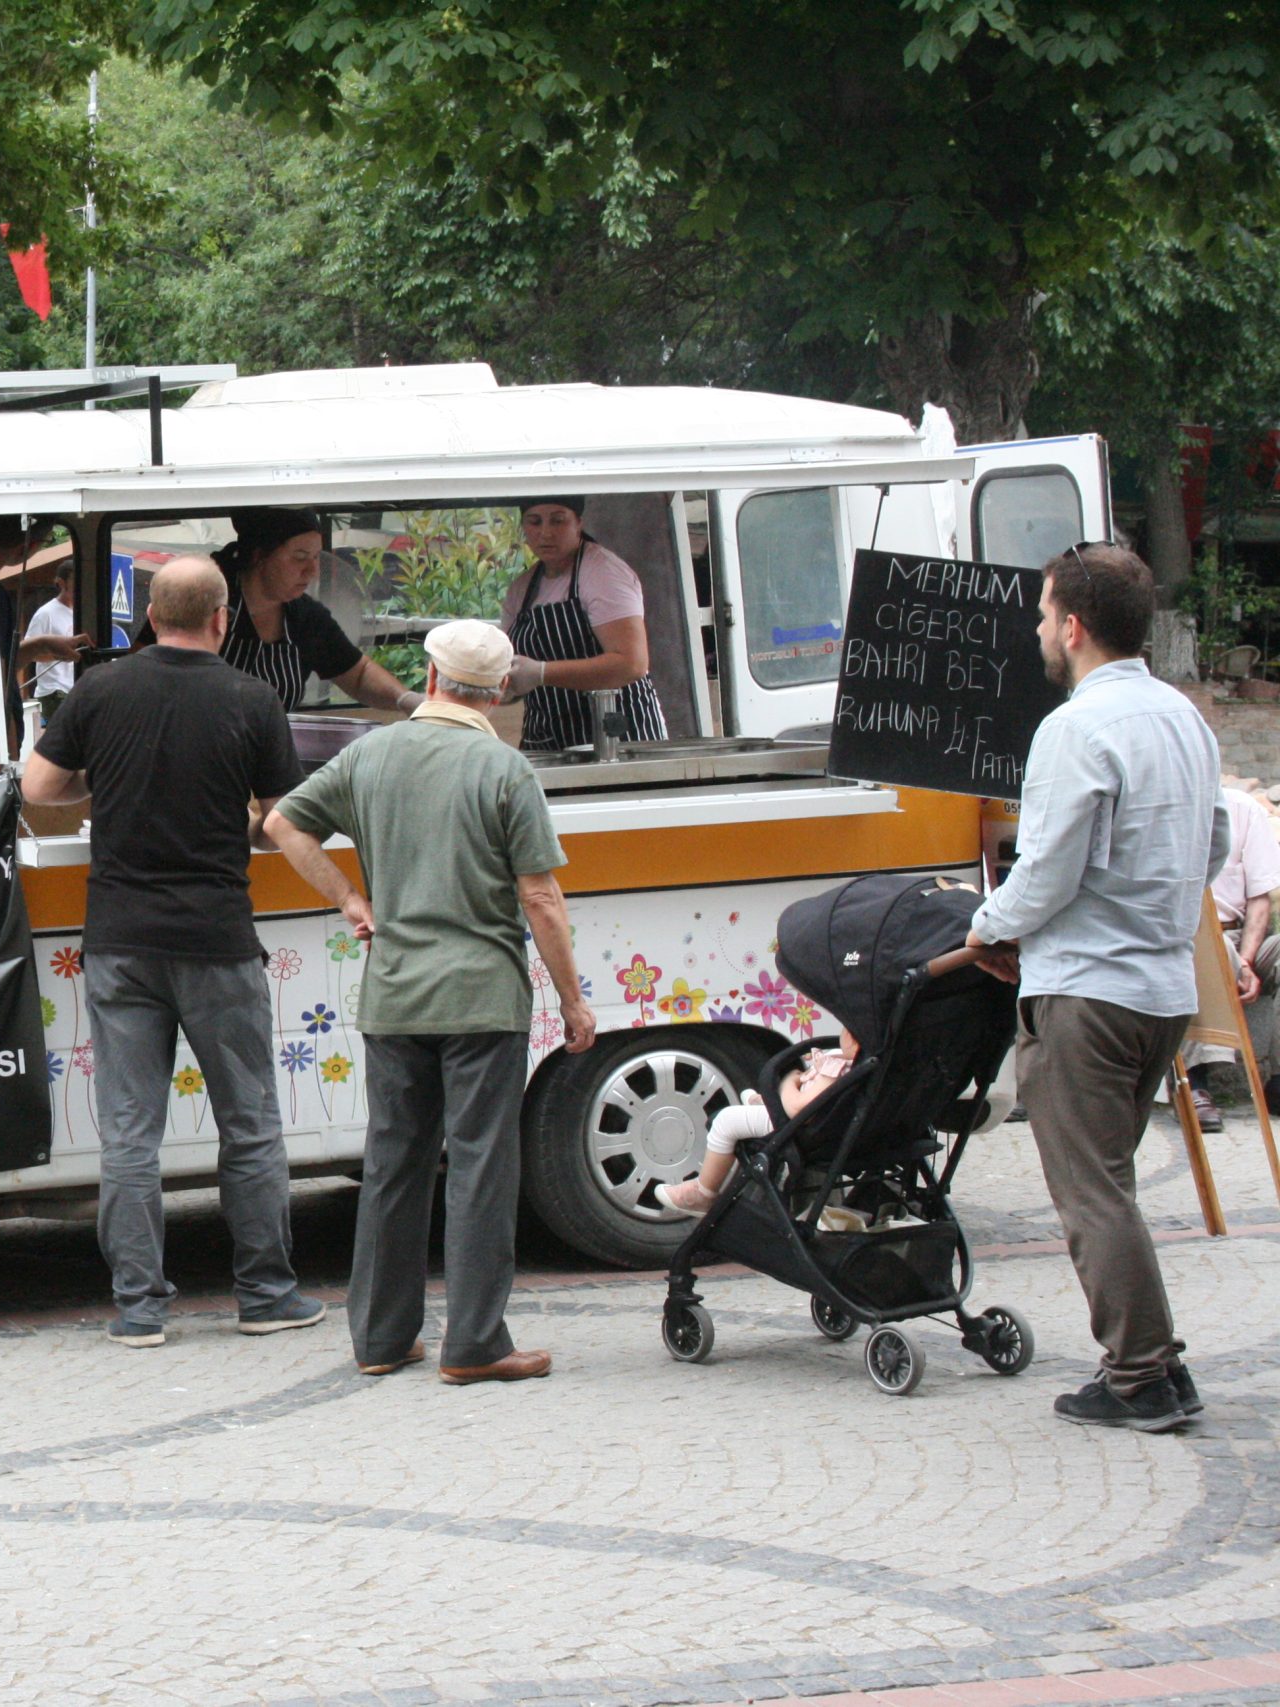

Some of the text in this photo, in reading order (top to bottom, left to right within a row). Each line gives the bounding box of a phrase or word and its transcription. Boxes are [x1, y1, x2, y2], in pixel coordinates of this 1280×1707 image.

[845, 638, 1008, 698] BAHRİ BEY
[837, 694, 940, 740] RUHUNA
